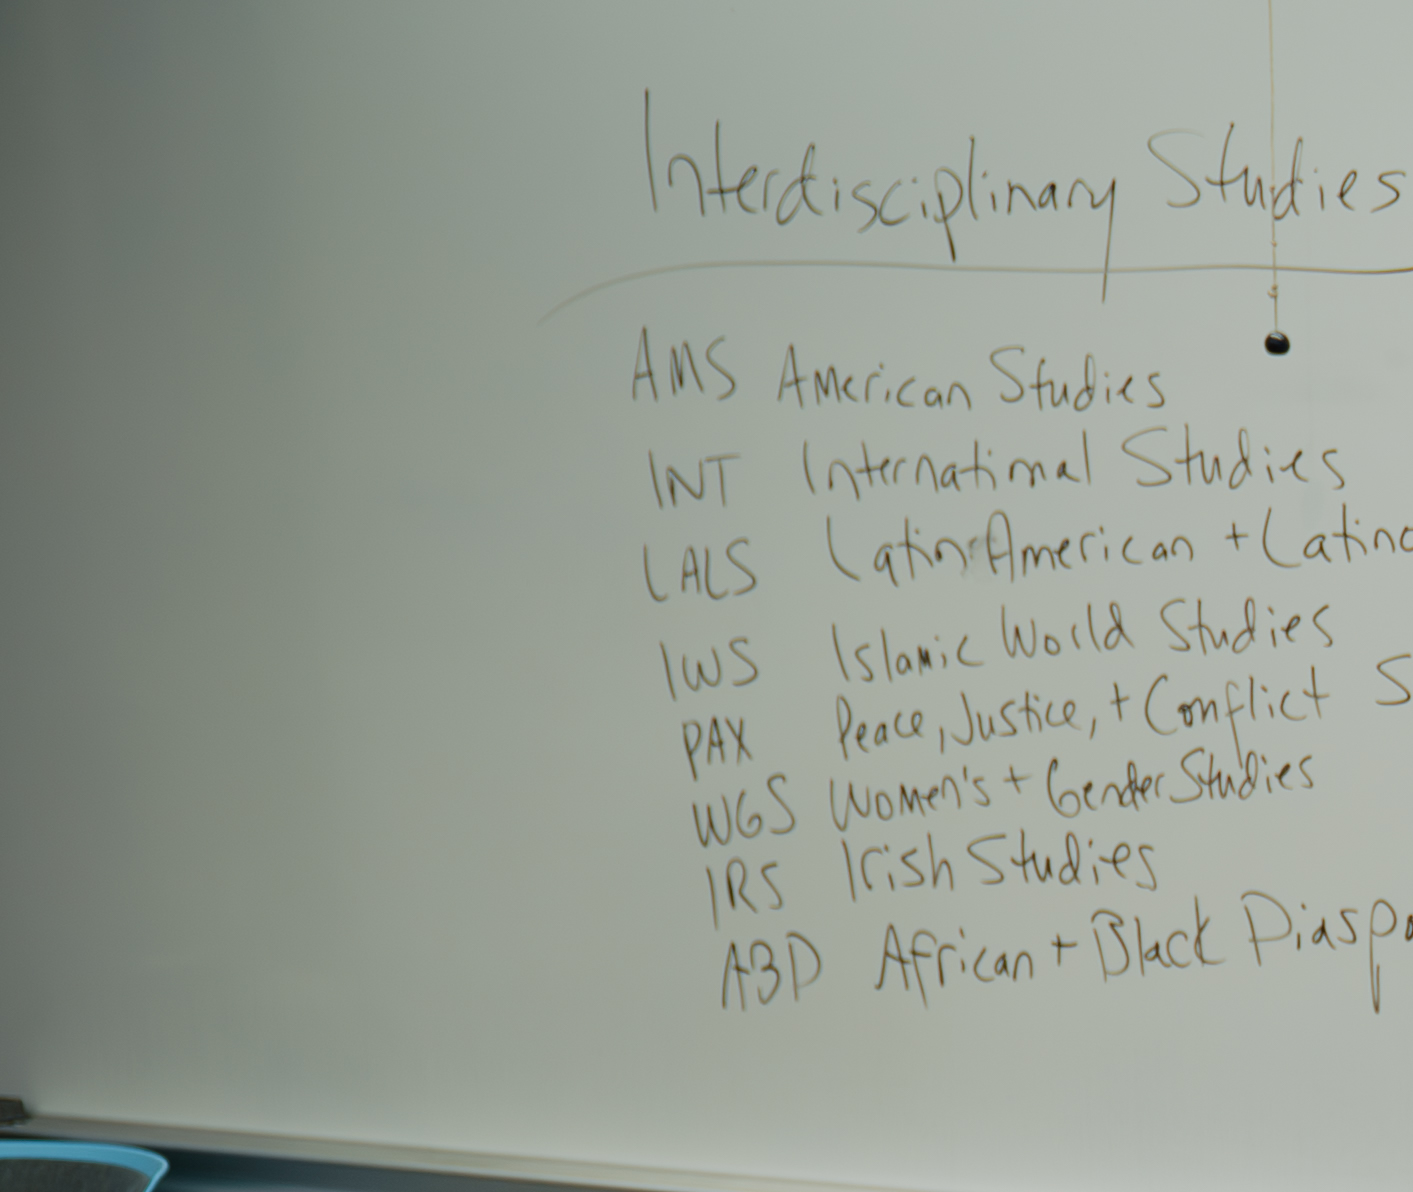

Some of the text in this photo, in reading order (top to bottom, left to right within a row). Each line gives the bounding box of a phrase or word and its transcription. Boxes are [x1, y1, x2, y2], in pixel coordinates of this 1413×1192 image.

[641, 88, 1401, 304] Interdisciplinary Studies
[631, 327, 1166, 410] AMS American Studies
[649, 423, 1345, 509] INT International Studies
[644, 537, 757, 602] LALS
[826, 515, 968, 588] Latin
[986, 509, 1195, 583] American
[1226, 522, 1249, 550] +
[659, 597, 1334, 701] IWS Islamic World Studies
[681, 716, 754, 778] PAX
[1145, 666, 1330, 760] Conflict
[692, 748, 1316, 848] WGS Women's + Gender Studies
[705, 829, 1159, 930] IRS Irish Studies
[875, 922, 1034, 1006] African
[1047, 936, 1078, 968] +
[1091, 894, 1227, 981] Black
